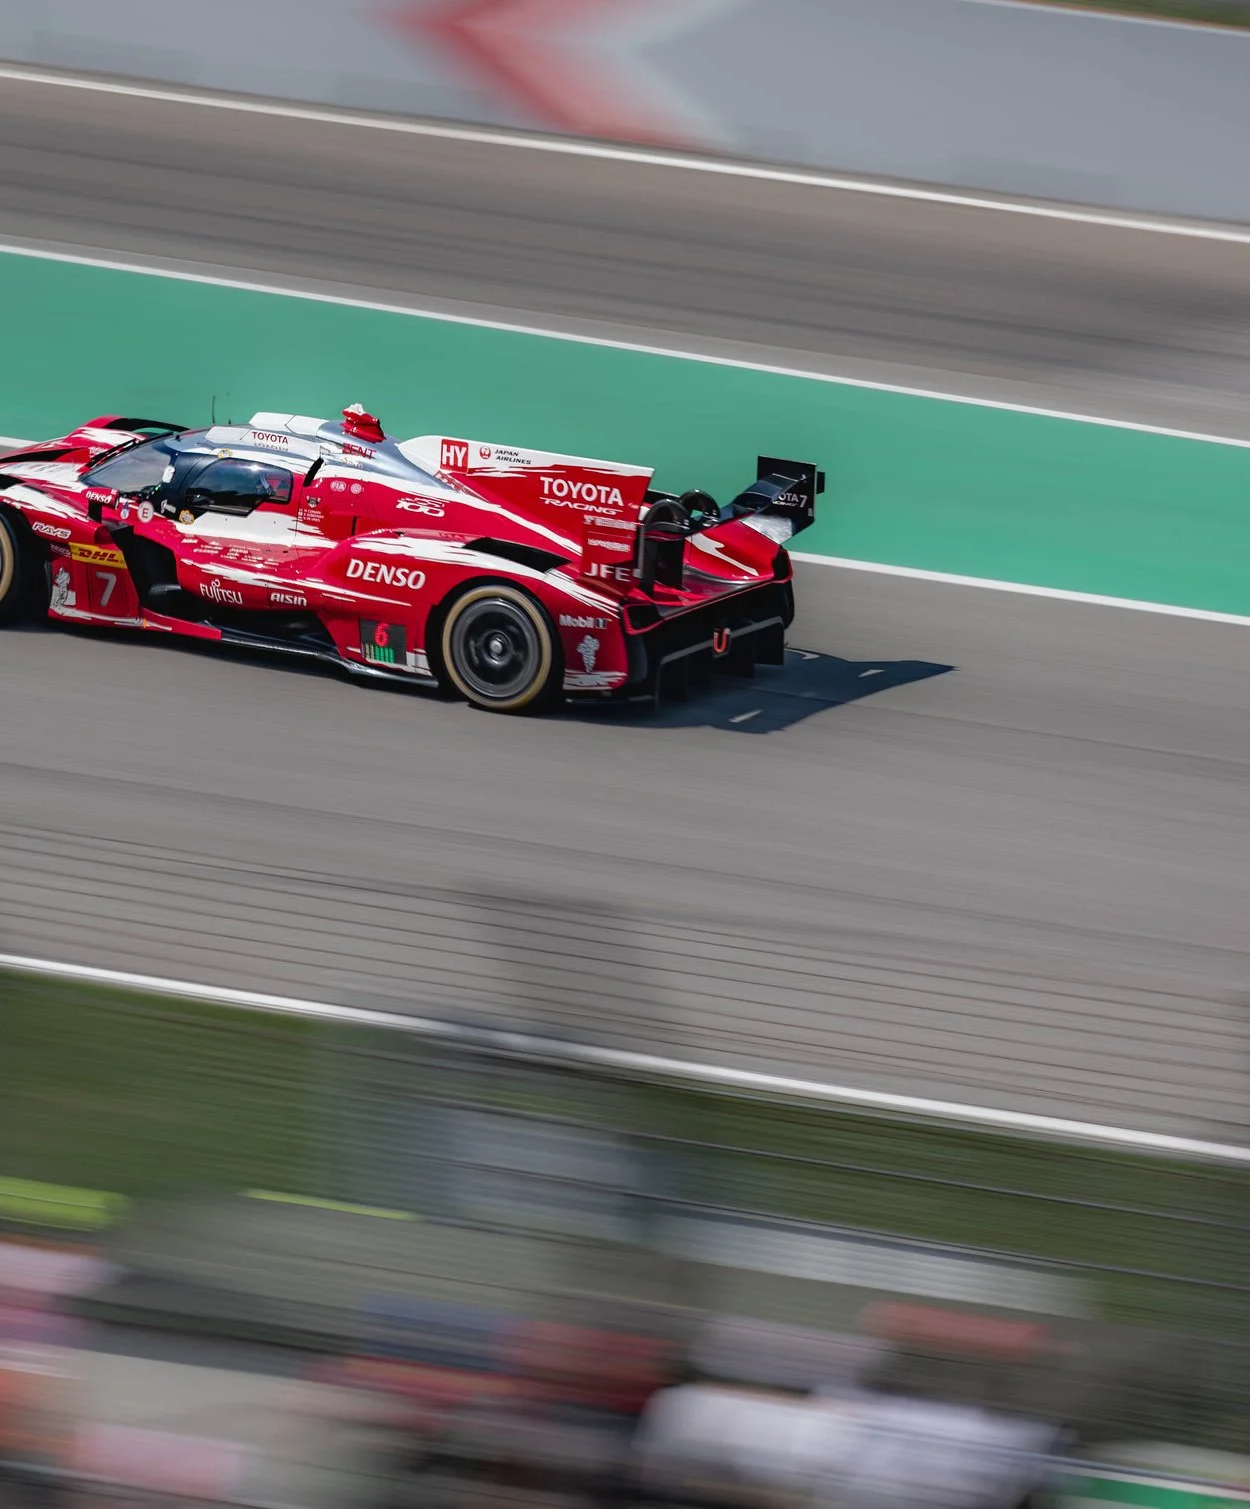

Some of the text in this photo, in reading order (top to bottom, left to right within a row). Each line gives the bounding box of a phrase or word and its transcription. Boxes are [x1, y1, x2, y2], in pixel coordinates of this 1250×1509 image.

[252, 431, 289, 445] TOYOTA
[342, 442, 377, 459] ZENT
[442, 444, 467, 467] HY
[494, 449, 519, 457] JAPAN
[495, 456, 532, 465] AIRLINES
[86, 490, 112, 504] DENSO
[540, 476, 624, 506] TOYOTA
[539, 496, 623, 515] RACING
[799, 494, 808, 508] 7
[142, 507, 149, 518] E
[32, 521, 71, 540] RAYS
[78, 547, 119, 563] DHL
[346, 558, 426, 590] DENSO
[583, 562, 631, 582] JFE
[95, 571, 117, 607] 7
[199, 578, 243, 605] FUJITSU
[559, 614, 594, 628] Mobil
[374, 622, 389, 648] 6
